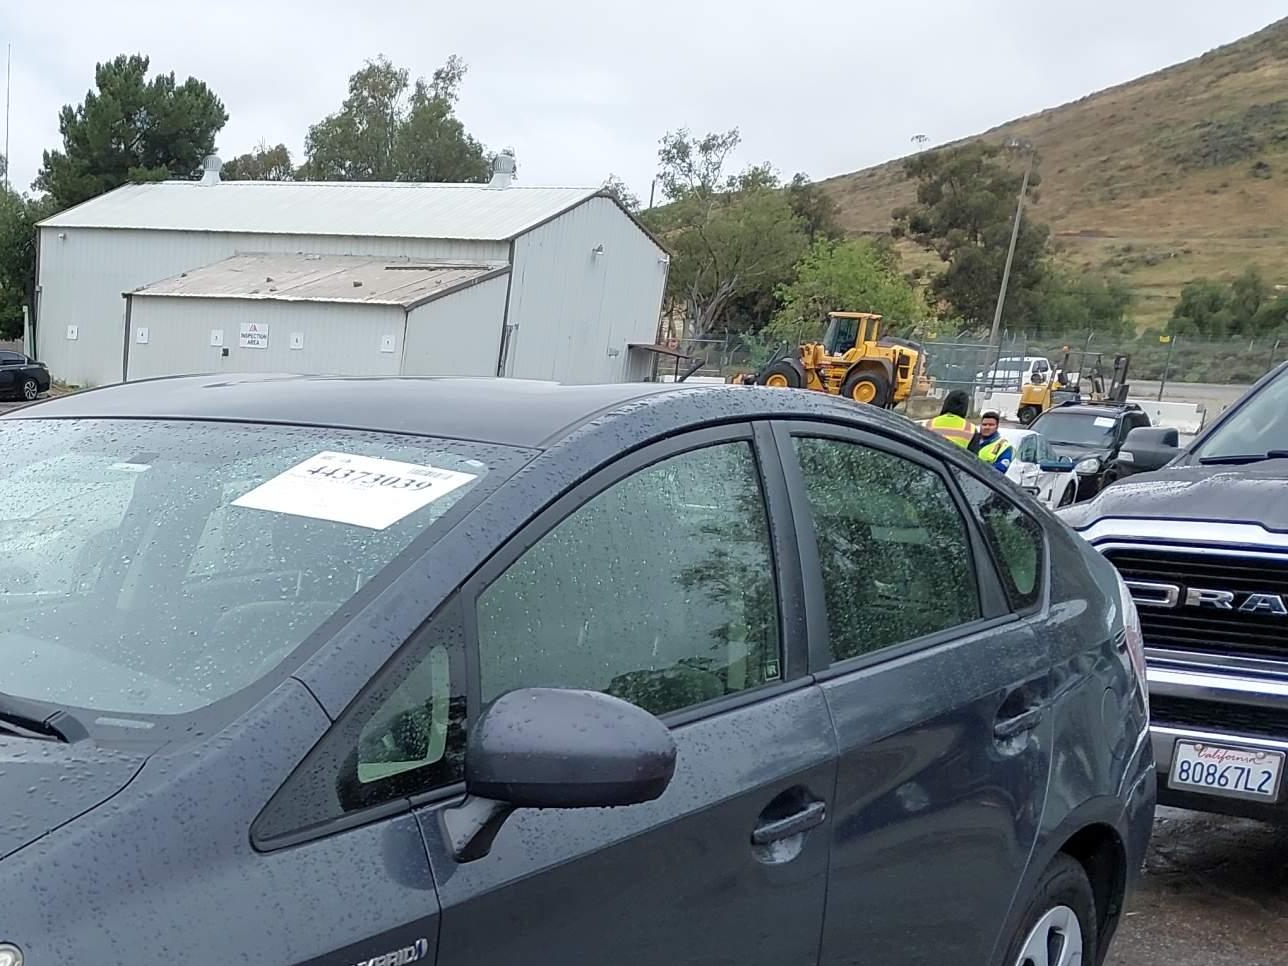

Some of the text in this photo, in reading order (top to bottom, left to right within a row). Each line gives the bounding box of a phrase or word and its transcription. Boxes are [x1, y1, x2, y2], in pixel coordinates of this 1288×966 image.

[307, 466, 432, 491] 44373039
[1197, 745, 1261, 764] California
[1178, 760, 1272, 795] 80867L2
